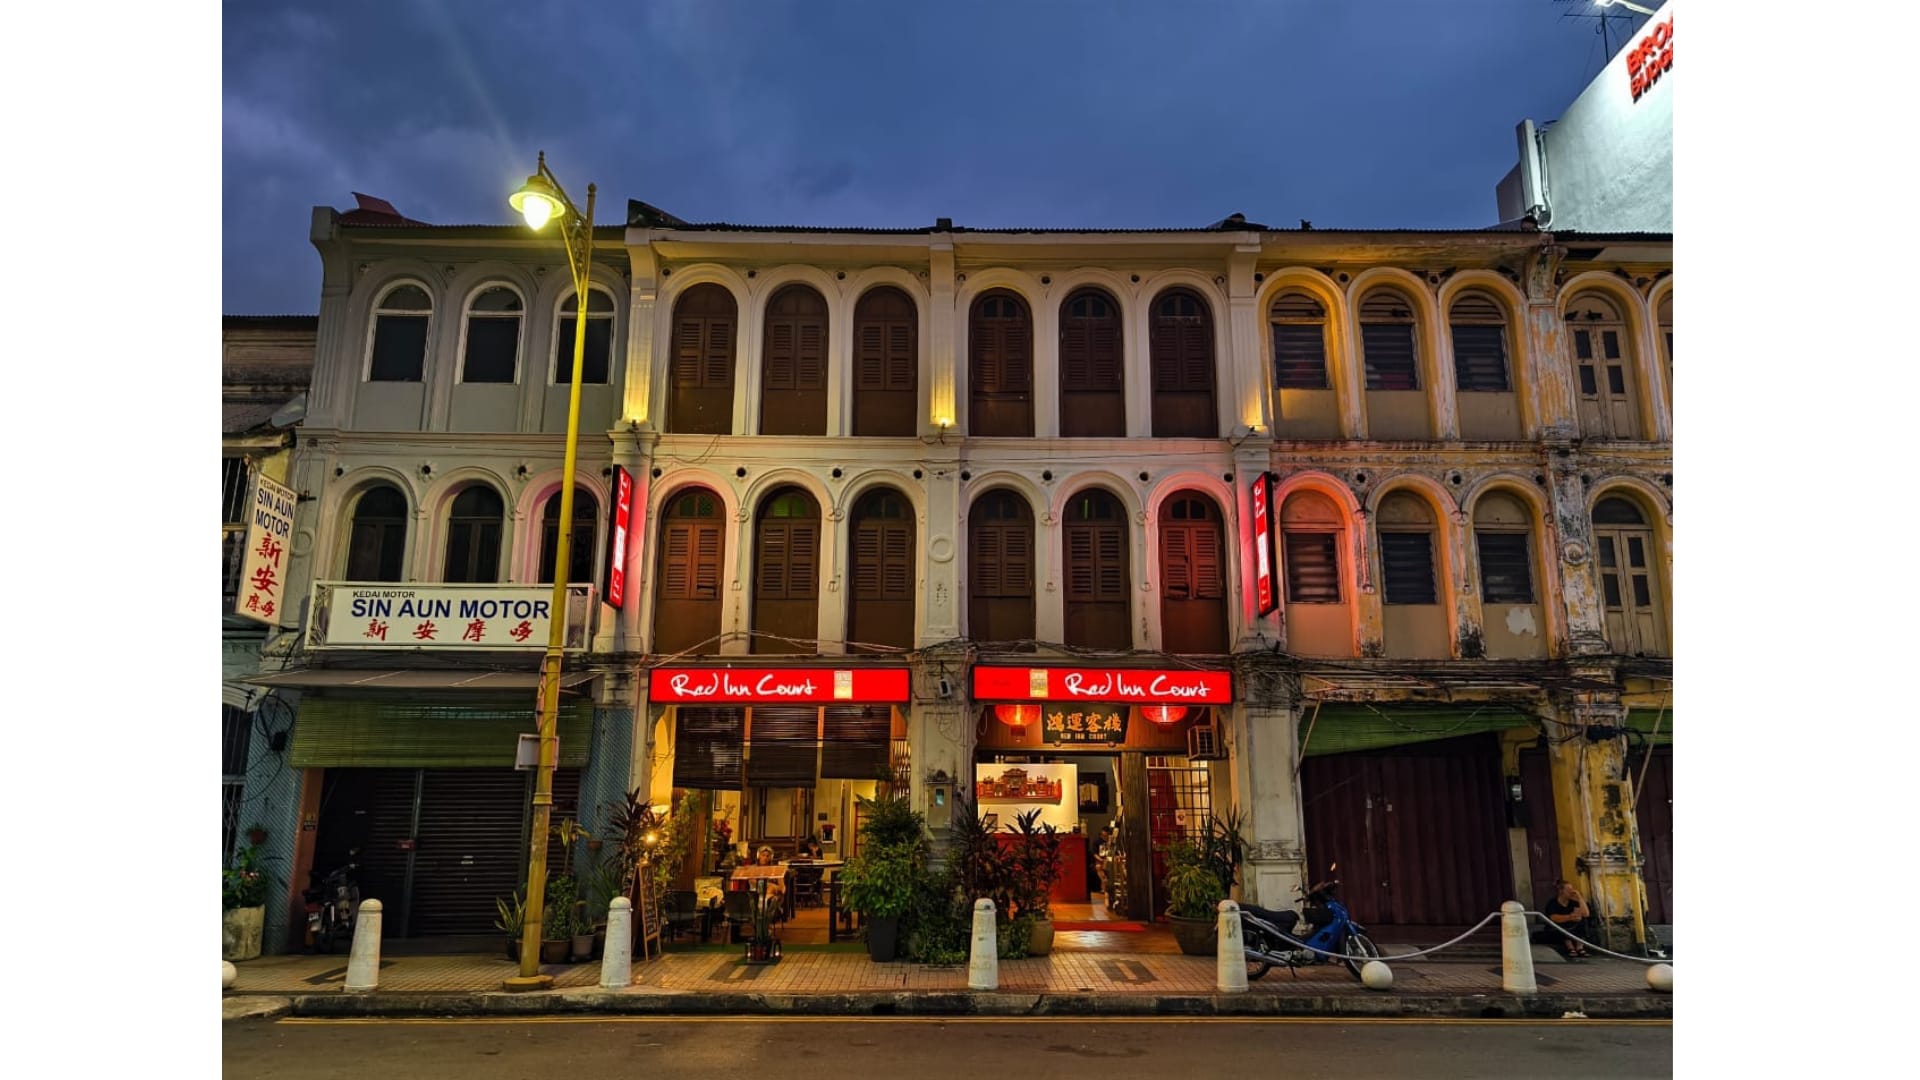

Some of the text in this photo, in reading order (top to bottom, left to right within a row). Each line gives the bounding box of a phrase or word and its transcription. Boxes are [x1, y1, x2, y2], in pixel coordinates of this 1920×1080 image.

[257, 487, 294, 520] SIN AUN
[255, 508, 290, 539] MOTOR
[382, 591, 416, 599] MOTOR
[351, 599, 549, 619] SIN AUN MOTOR
[670, 673, 719, 697] Red
[723, 673, 752, 696] Inn
[755, 674, 817, 696] Court
[1064, 672, 1112, 696] Red
[1116, 673, 1146, 696] Inn
[1149, 675, 1211, 697] Court
